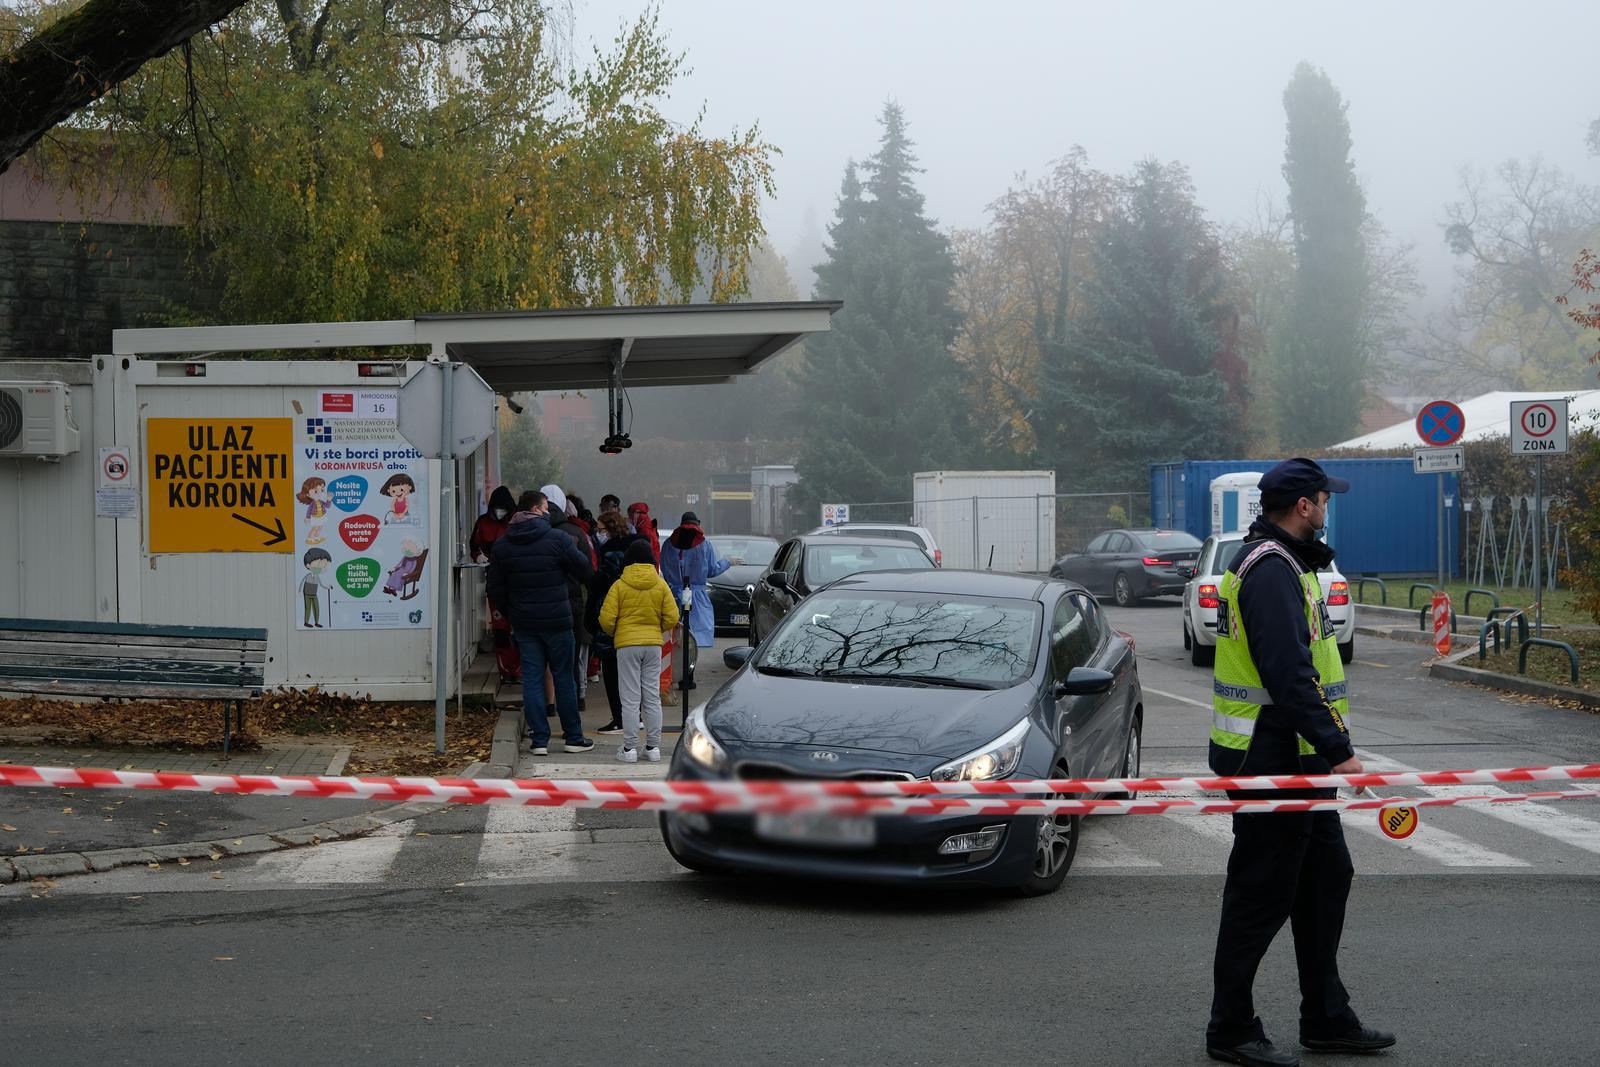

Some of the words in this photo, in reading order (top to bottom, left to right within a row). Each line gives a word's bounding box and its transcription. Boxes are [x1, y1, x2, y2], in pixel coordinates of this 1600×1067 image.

[373, 403, 386, 413] 16
[1530, 412, 1546, 428] 10
[188, 426, 253, 451] ULAZ
[1523, 440, 1556, 451] ZONA
[305, 448, 319, 459] Vi
[323, 448, 342, 459] ste
[345, 448, 379, 459] borci
[155, 454, 287, 479] PACIJENTI
[315, 462, 384, 470] KORONAVIRUSA
[387, 462, 407, 470] ako:
[169, 482, 276, 508] KORONA
[812, 751, 834, 761] KIA
[1388, 807, 1410, 832] STOP
